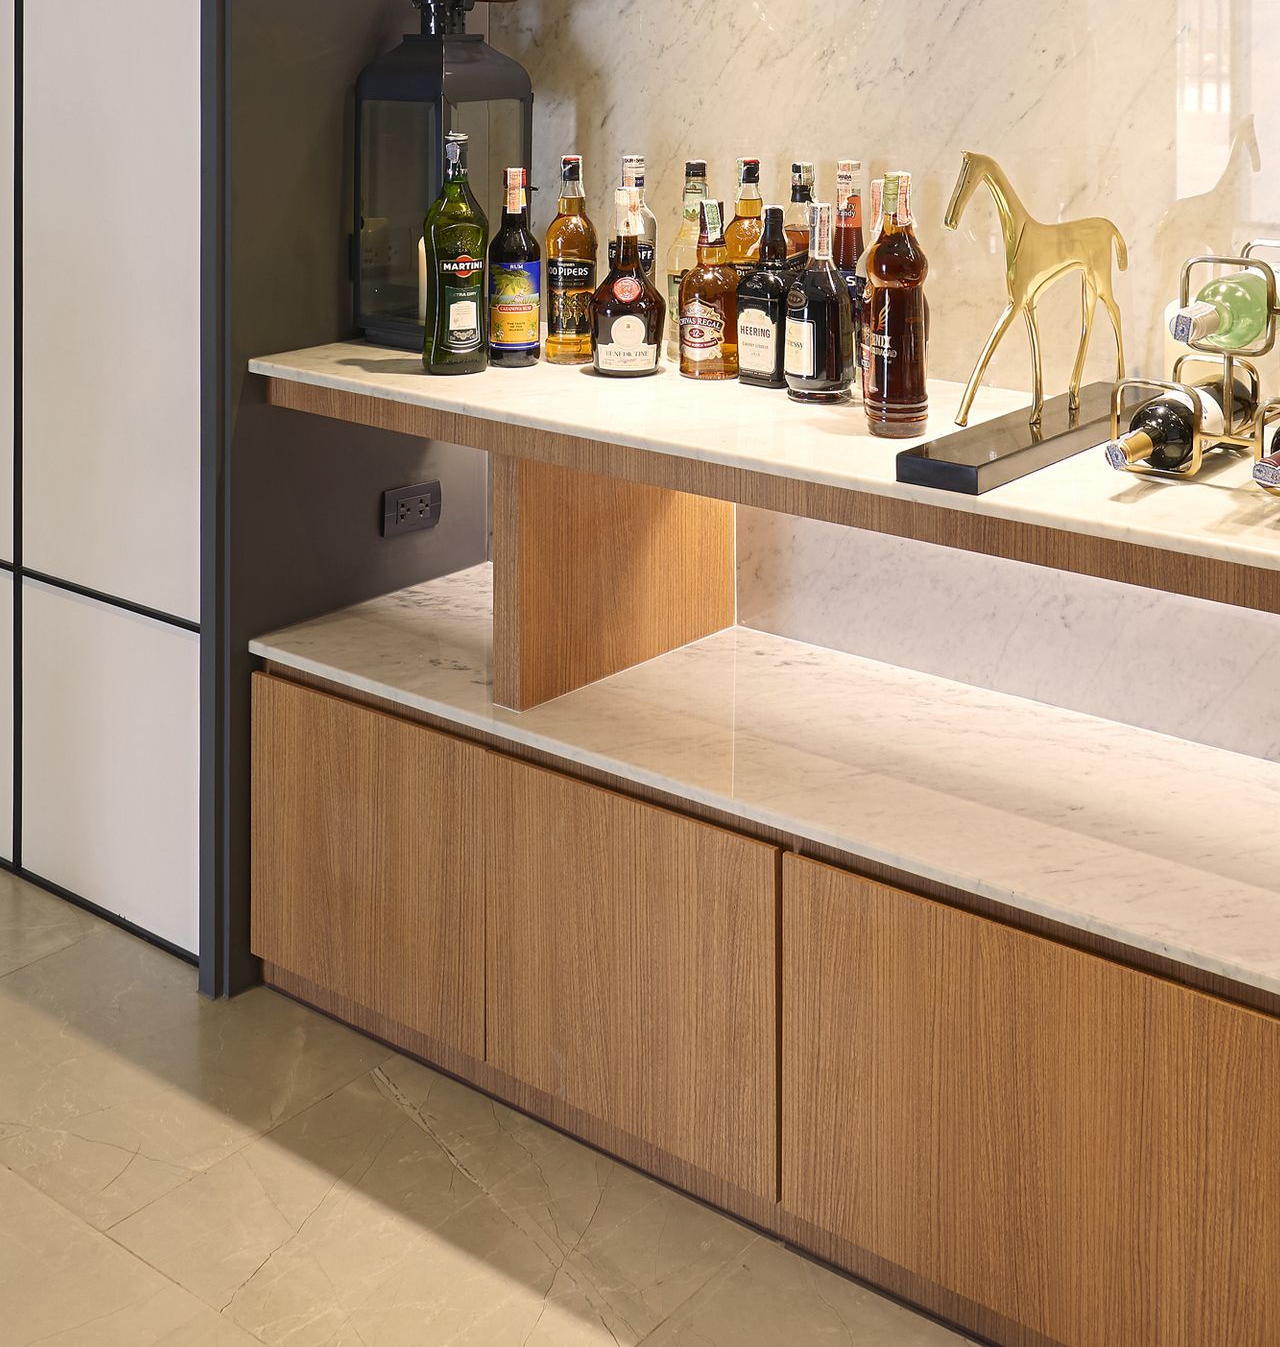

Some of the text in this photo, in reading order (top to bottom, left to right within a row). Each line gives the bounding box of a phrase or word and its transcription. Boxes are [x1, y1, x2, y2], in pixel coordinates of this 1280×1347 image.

[443, 261, 483, 271] MARTINI
[558, 266, 589, 276] PIPERS
[697, 317, 721, 330] REGAL
[740, 325, 771, 339] HEERING
